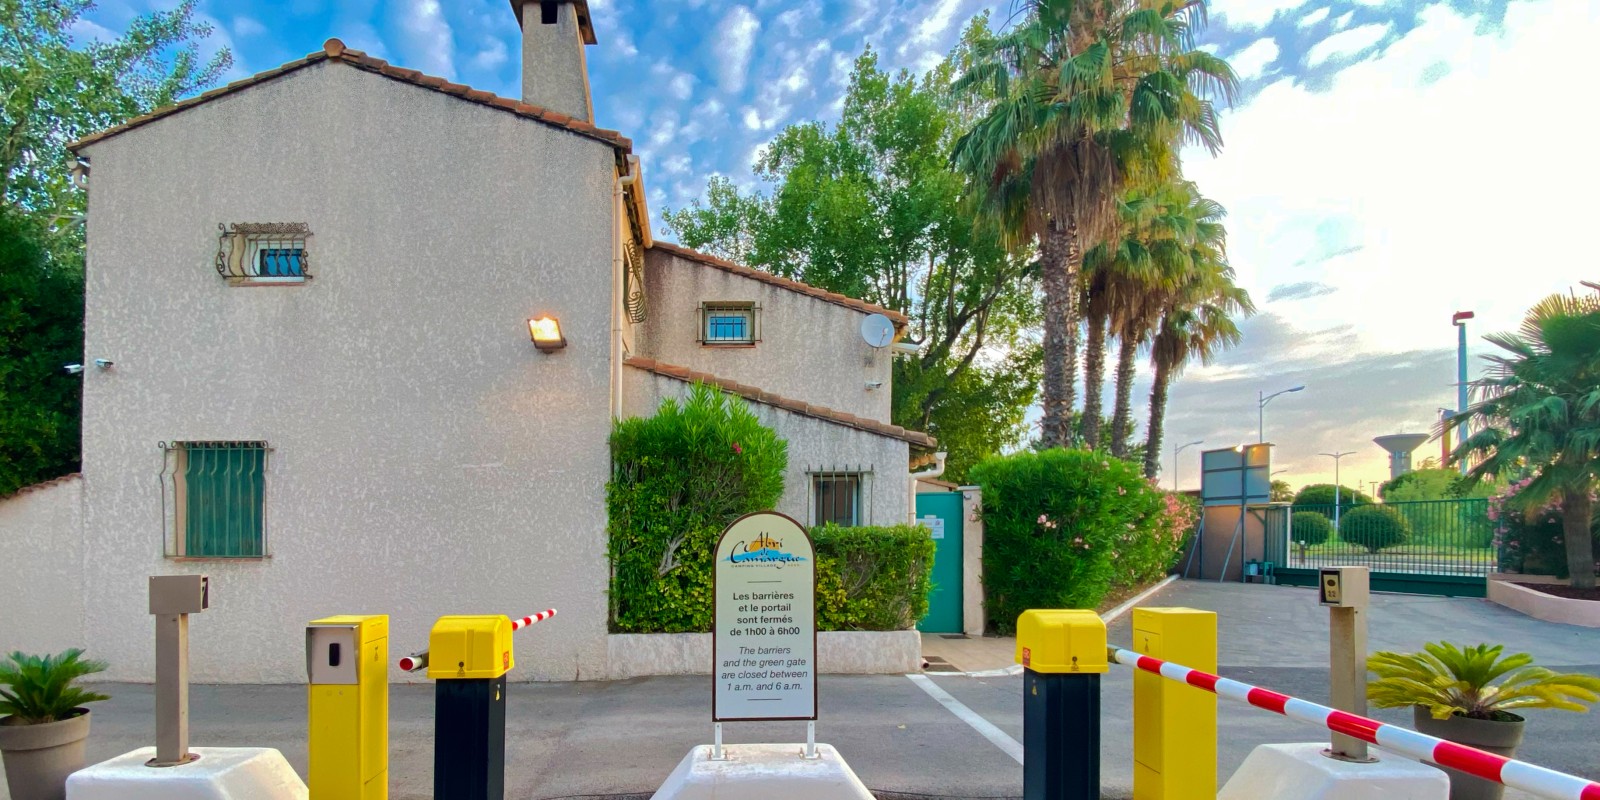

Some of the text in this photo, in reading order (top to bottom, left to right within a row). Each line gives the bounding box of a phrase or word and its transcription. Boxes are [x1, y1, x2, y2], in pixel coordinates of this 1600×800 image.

[744, 531, 783, 552] Abri
[730, 540, 800, 569] Camargue
[760, 547, 769, 556] de
[733, 591, 794, 601] Les barrières
[738, 603, 791, 613] et le portail
[737, 614, 793, 624] sont fermés
[730, 626, 800, 636] de 1h00 à 6h00
[739, 646, 791, 655] The barriers
[723, 658, 807, 668] and the green gate
[738, 670, 768, 679] closed
[769, 670, 808, 678] between
[727, 683, 732, 691] 1
[756, 682, 774, 690] and
[775, 682, 782, 690] 6
